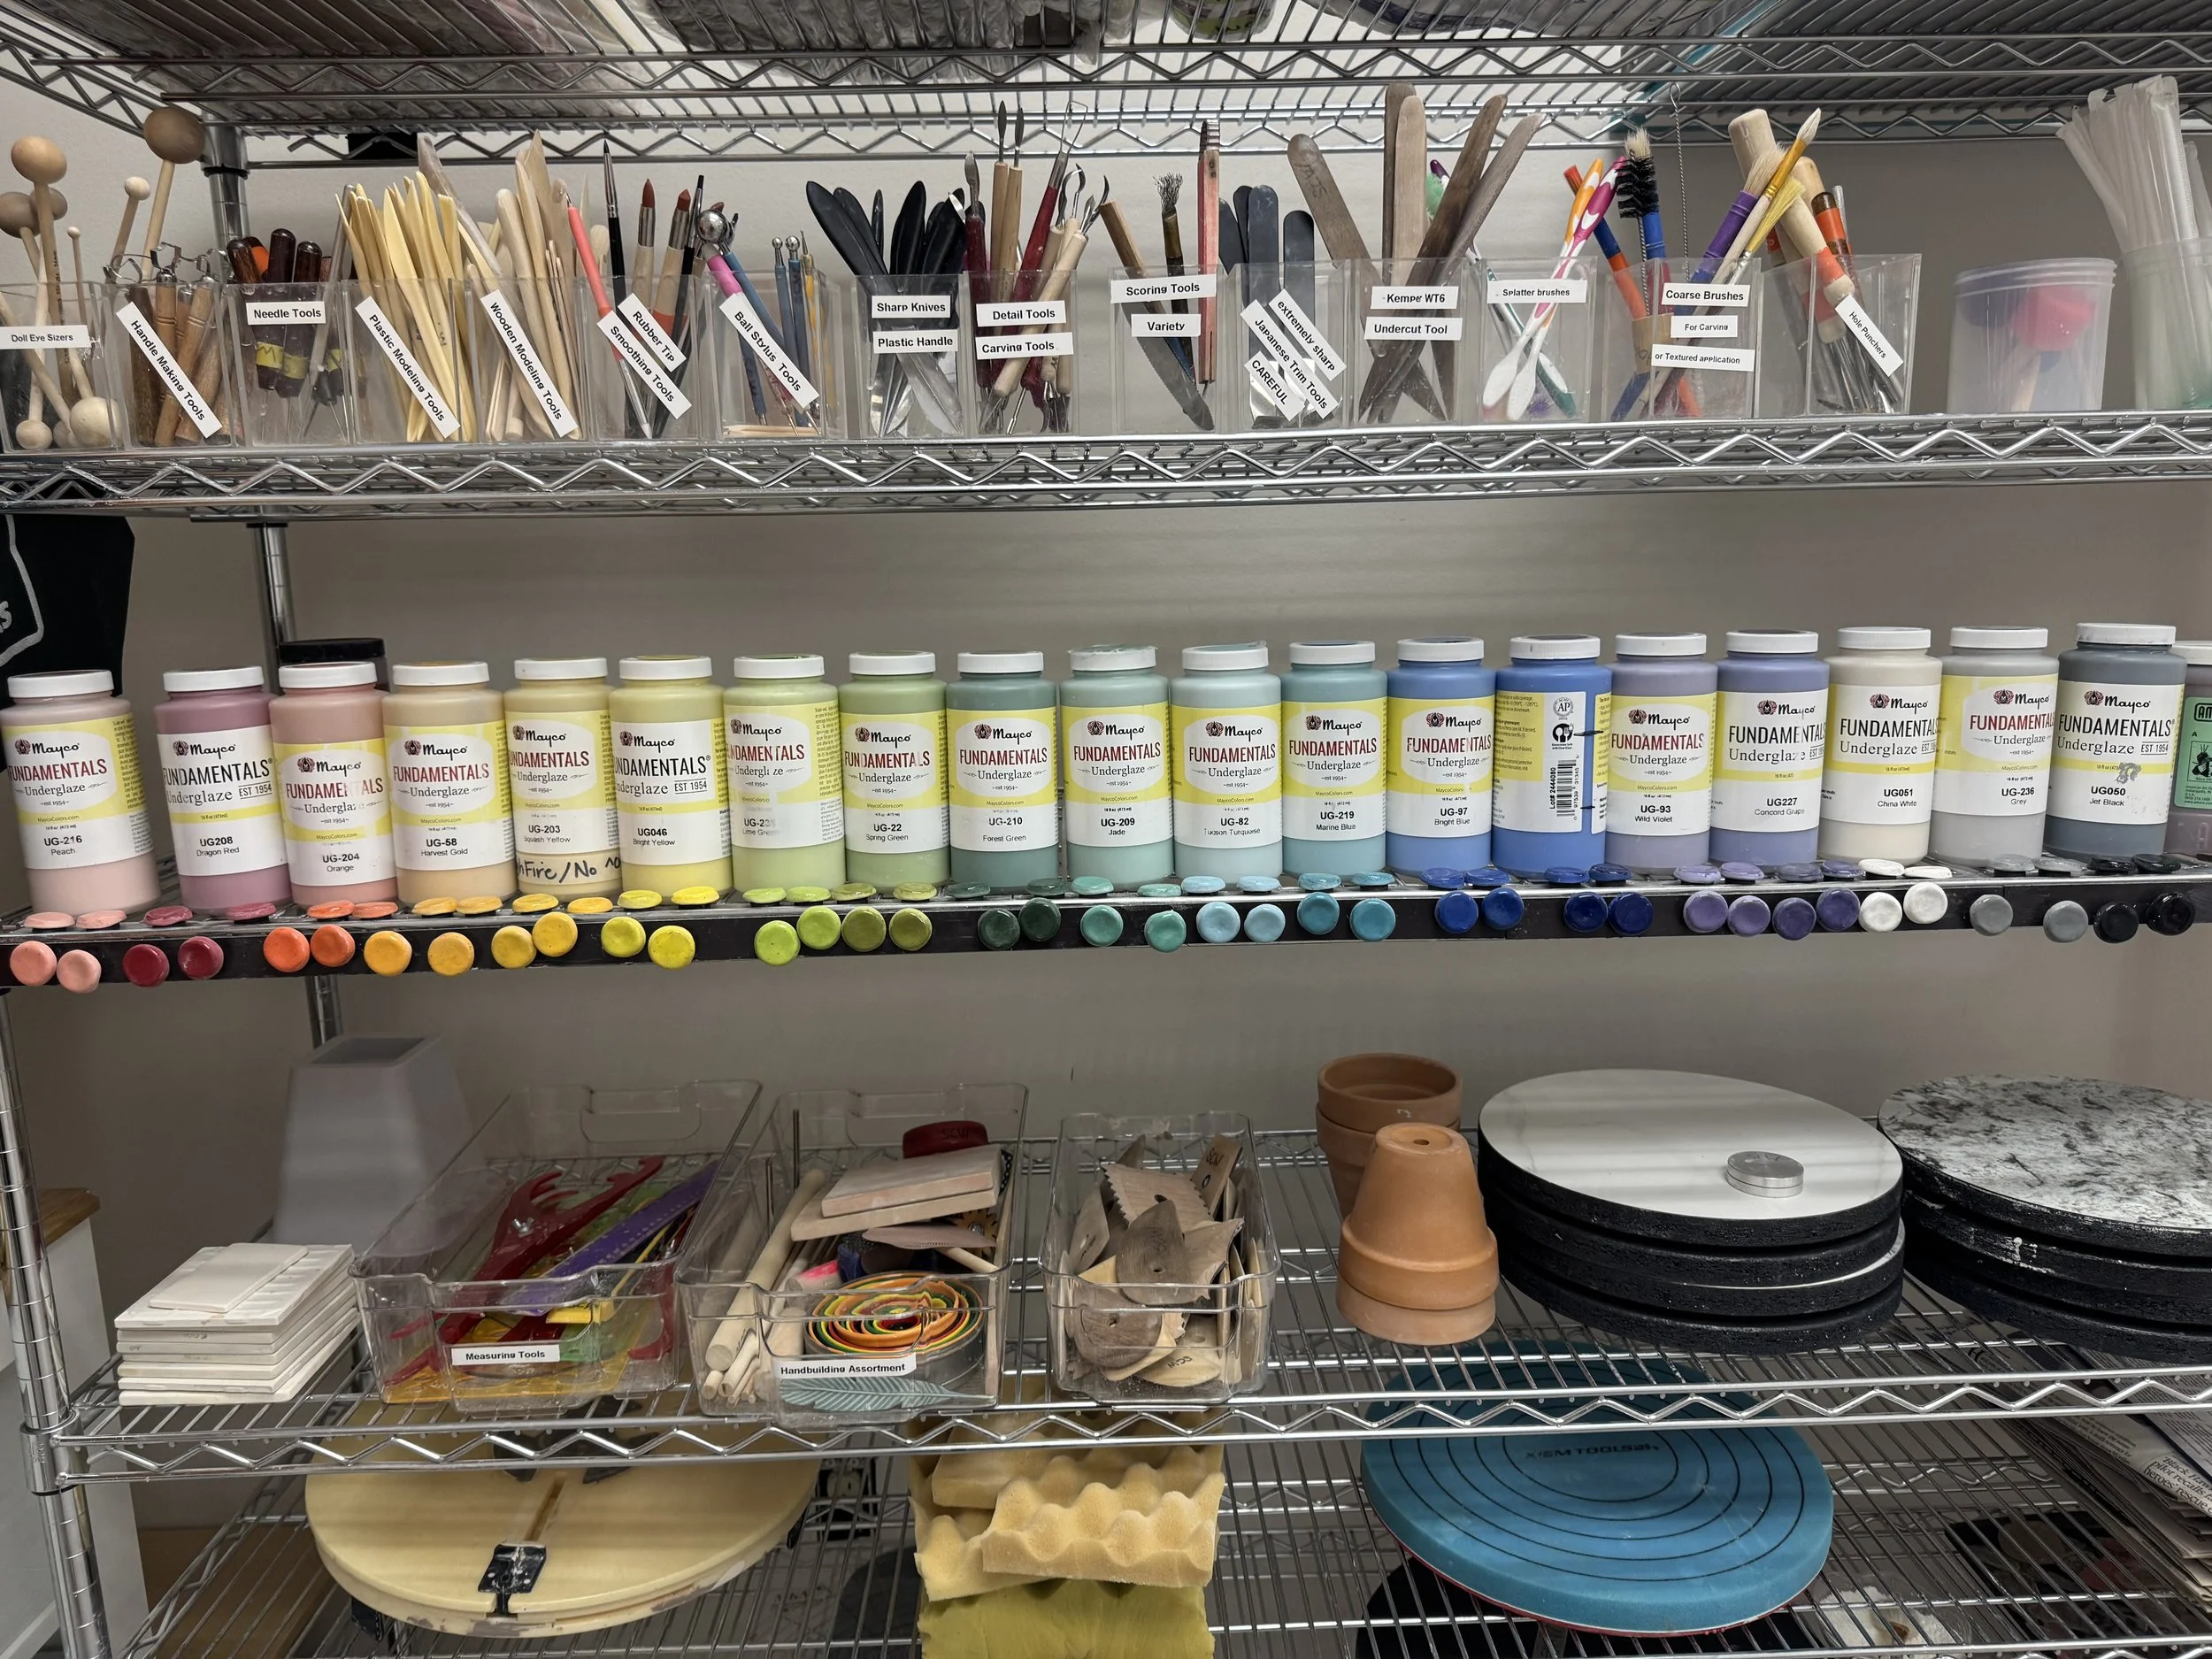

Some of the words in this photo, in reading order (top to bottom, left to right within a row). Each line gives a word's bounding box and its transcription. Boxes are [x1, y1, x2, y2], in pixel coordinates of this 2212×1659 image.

[1125, 285, 1168, 296] Scoring
[1170, 282, 1200, 294] Tools
[1537, 288, 1571, 296] brushes
[1665, 289, 1701, 300] Coarse
[1703, 290, 1744, 301] Brushes
[1386, 293, 1423, 303] Kemper
[1425, 293, 1446, 303] WT6
[253, 307, 290, 319] Needle
[291, 306, 323, 319] Tools
[877, 303, 909, 312] Sharp
[911, 302, 946, 312] Knives
[992, 310, 1023, 320] Detail
[1025, 308, 1056, 319] Tools
[1147, 321, 1186, 331] Variety
[1374, 324, 1422, 334] Undercut
[1424, 324, 1448, 334] Tool
[11, 334, 28, 342] Doll
[29, 334, 46, 342] Eye
[633, 311, 663, 346] Rubber
[661, 344, 675, 362] Tip
[1278, 301, 1315, 344] extremely
[1312, 345, 1335, 371] sharp
[1848, 311, 1863, 328] Hole
[1861, 326, 1886, 359] Punchers
[878, 337, 914, 348] Plastic
[917, 336, 953, 347] Handle
[981, 343, 1023, 354] Carving
[1025, 341, 1055, 351] Tools
[734, 311, 754, 333] Ball
[750, 331, 777, 362] Stylus
[778, 362, 801, 392] Tools
[490, 302, 518, 343] Wooden
[514, 343, 545, 390] Modeling
[539, 389, 562, 426] Tools
[611, 326, 653, 376] Smoothing
[652, 373, 674, 402] Tools
[1255, 319, 1290, 363] Japanese
[1289, 359, 1307, 384] Trim
[1306, 380, 1327, 410] Tools
[1664, 352, 1699, 362] Textured
[1699, 355, 1740, 365] application
[130, 319, 158, 357] Handle
[156, 356, 185, 392] Making
[183, 391, 205, 421] Tools
[369, 314, 395, 349] Plastic
[392, 348, 426, 393] Modeling
[424, 391, 445, 421] Tools
[1251, 359, 1287, 405] CAREFUL
[1557, 702, 1571, 712] AP
[1890, 698, 1928, 715] Mayco
[2015, 694, 2050, 710] Mayco
[2104, 695, 2151, 714] Mayco
[1778, 703, 1816, 720] Mayco
[1322, 718, 1362, 736] Mayco
[1445, 717, 1482, 733] Mayco
[1647, 713, 1690, 731] Mayco
[526, 729, 566, 748] Mayco
[742, 724, 782, 741] Mayco
[993, 727, 1033, 745] Mayco
[1105, 724, 1144, 741] Mayco
[1224, 725, 1263, 742] Mayco
[634, 735, 675, 753] Mayco
[871, 732, 910, 749] Mayco
[1288, 737, 1377, 757] FUNDAMENTALS
[1610, 733, 1705, 751] FUNDAMENTALS
[1993, 734, 2046, 747] Underglaze
[2057, 736, 2135, 756] Underglaze
[2140, 743, 2154, 753] EST
[2155, 743, 2169, 753] 1954
[31, 742, 80, 759] Mayco
[189, 743, 236, 759] Mayco
[422, 744, 467, 761] Mayco
[959, 747, 1048, 765] FUNDAMENTALS
[1073, 741, 1161, 762] FUNDAMENTALS
[1188, 743, 1276, 764] FUNDAMENTALS
[1839, 741, 1918, 759] Underglaze
[1307, 760, 1361, 772] Underglaze
[1427, 757, 1480, 769] Underglaze
[1629, 755, 1687, 766] Underglaze
[8, 758, 107, 782] FUNDAMENTALS
[316, 762, 361, 778] Mayco
[393, 764, 490, 783] FUNDAMENTALS
[977, 769, 1033, 781] Underglaze
[1091, 764, 1146, 777] Underglaze
[1208, 766, 1262, 779] Underglaze
[516, 772, 568, 784] Underglaze
[858, 772, 912, 785] Underglaze
[25, 783, 86, 799] Underglaze
[255, 784, 273, 795] 1954
[690, 780, 708, 791] 1954
[2001, 787, 2035, 797] UG-236
[2091, 786, 2126, 795] UG050
[410, 786, 470, 799] Underglaze
[1883, 788, 1914, 797] UG051
[1766, 797, 1798, 807] UG227
[1319, 810, 1355, 820] UG-219
[1440, 807, 1468, 817] UG-97
[1640, 804, 1671, 814] UG-93
[988, 817, 1023, 826] UG-210
[1100, 818, 1135, 827] UG-209
[1220, 817, 1249, 826] UG-82
[1634, 815, 1651, 824] Wild
[528, 825, 561, 834] UG-203
[637, 828, 668, 837] UG046
[873, 824, 902, 833] UG-22
[43, 835, 82, 847] UG-216
[199, 836, 234, 847] UG208
[426, 838, 457, 848] UG-58
[50, 848, 75, 856] Peach
[196, 849, 222, 858] Dragon
[224, 847, 240, 856] Red
[322, 853, 360, 864] UG-204
[449, 848, 468, 856] Gold
[326, 864, 355, 873] Orange
[465, 1352, 516, 1361] Measuring
[518, 1350, 546, 1359] Tools
[780, 1365, 846, 1375] Handbuilding
[849, 1363, 905, 1373] Assortment
[2149, 1461, 2176, 1478] pilot
[2173, 1472, 2207, 1495] recalls
[2176, 1487, 2208, 1509] rescue
